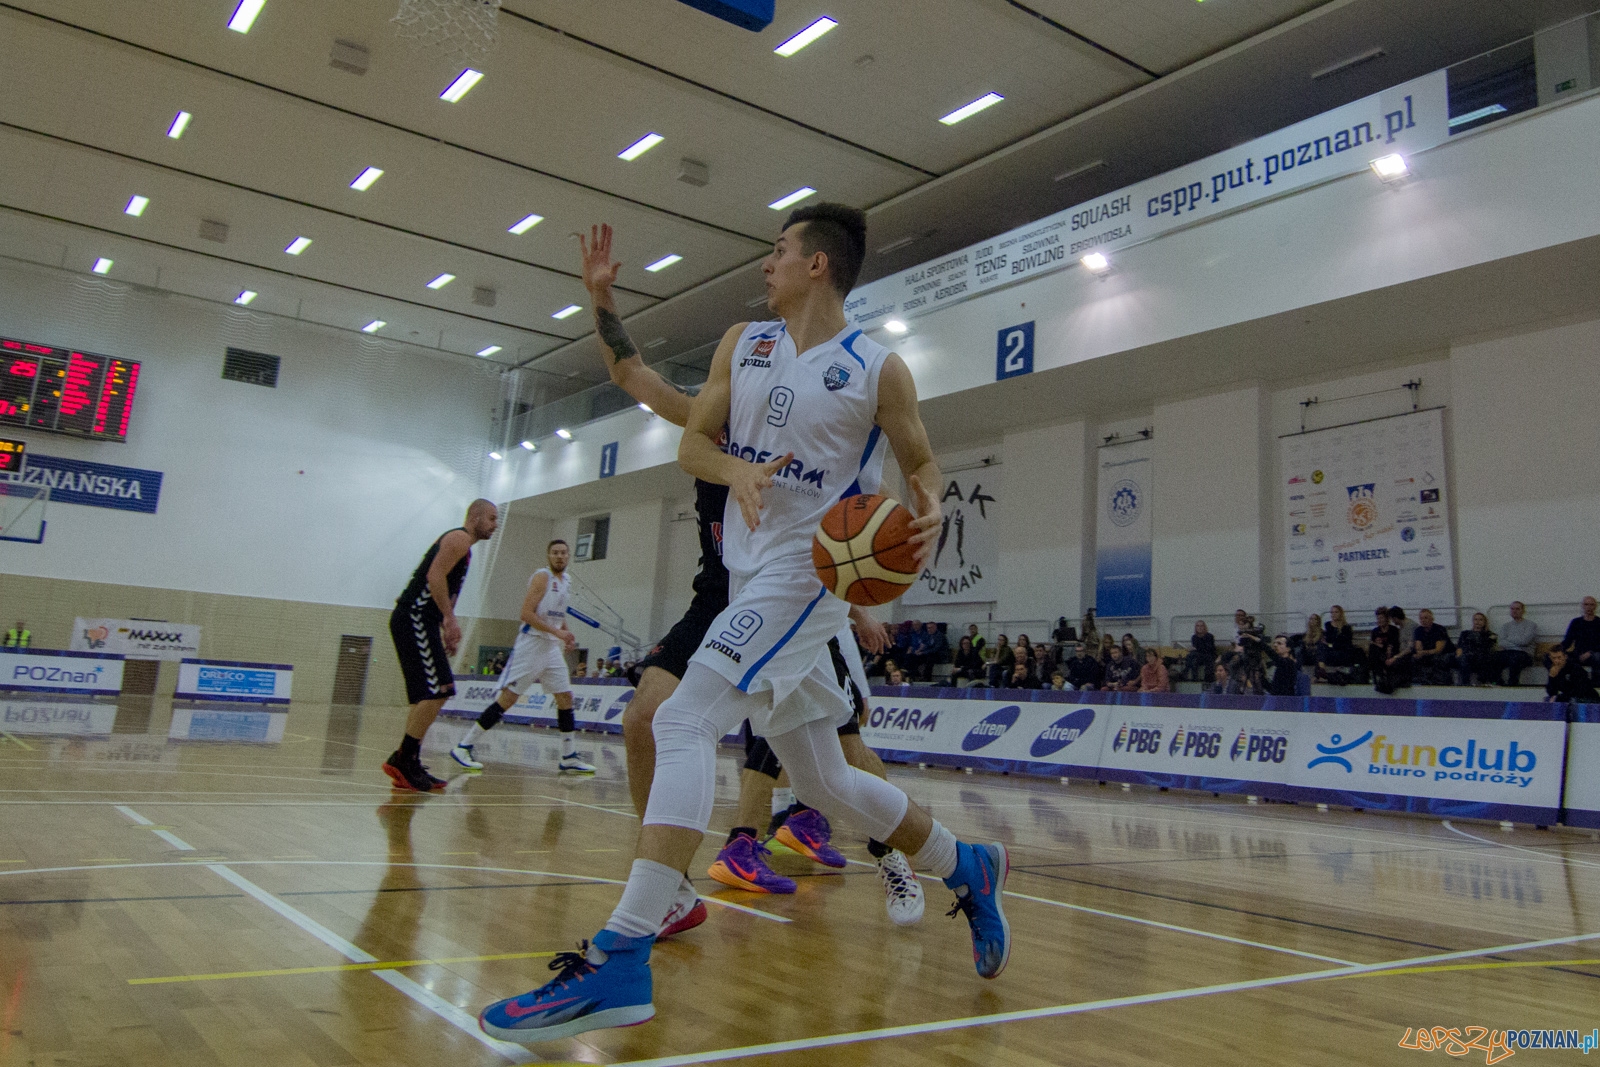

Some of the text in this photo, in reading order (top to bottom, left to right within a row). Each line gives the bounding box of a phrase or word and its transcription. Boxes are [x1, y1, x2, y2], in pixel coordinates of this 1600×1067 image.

[1146, 95, 1416, 218] cspp.put.poznan.pl
[1071, 194, 1132, 232] SQUASH
[904, 254, 969, 286] HALA SPORTOWA
[975, 254, 1007, 276] TENIS
[1011, 245, 1065, 275] BOWLING
[1005, 330, 1025, 373] 2
[766, 385, 795, 428] 9
[603, 447, 611, 474] 1
[920, 564, 983, 595] POZNAŃ
[128, 628, 183, 643] MAXXX
[719, 609, 763, 647] 9
[972, 720, 1007, 736] atrem
[1041, 724, 1080, 741] atrem
[1126, 728, 1162, 754] PBG
[1187, 724, 1225, 732] fundacja
[1250, 727, 1291, 736] fundacja
[1183, 731, 1222, 758] PBG
[1246, 735, 1288, 763] PBG
[1369, 734, 1537, 773] funclub
[1368, 764, 1533, 788] biuro podróży
